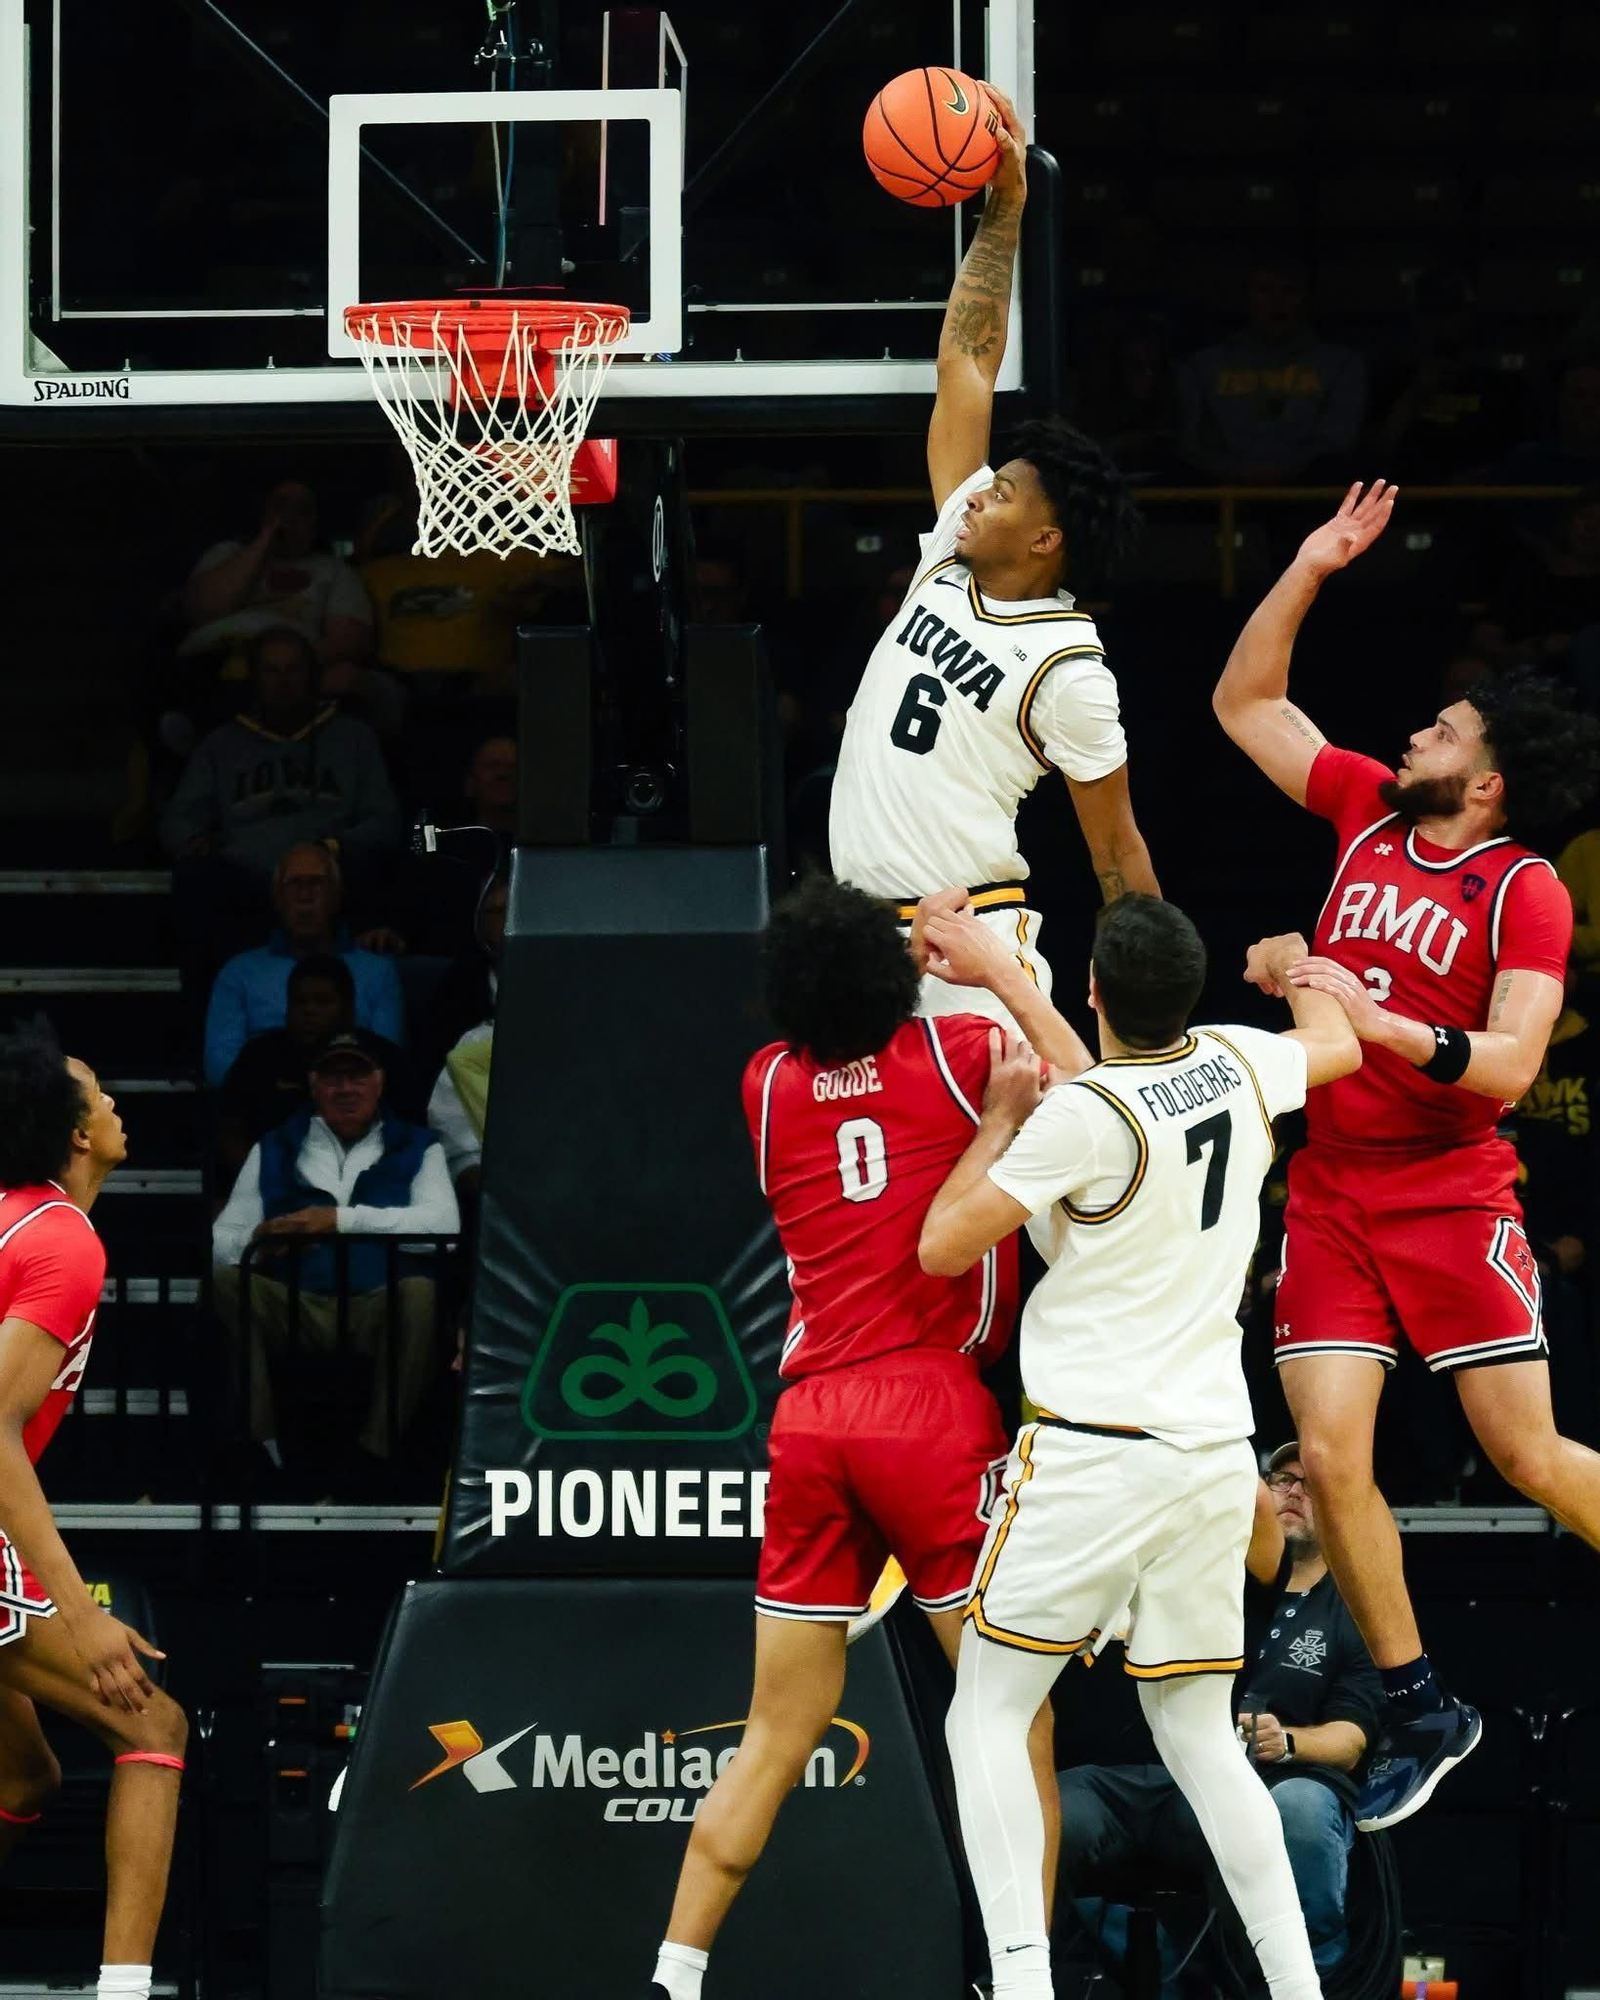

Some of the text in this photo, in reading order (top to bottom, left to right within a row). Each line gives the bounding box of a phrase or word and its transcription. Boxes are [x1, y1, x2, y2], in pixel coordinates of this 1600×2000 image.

[33, 378, 129, 402] SPALDING
[895, 604, 1006, 713] IOWA
[889, 672, 948, 755] 6
[1327, 882, 1469, 976] RMU
[812, 1054, 884, 1103] GOODE
[1137, 1054, 1242, 1122] FOLGUEIRAS
[836, 1116, 889, 1203] 0
[1184, 1109, 1232, 1232] 7
[603, 1798, 705, 1822] COU
